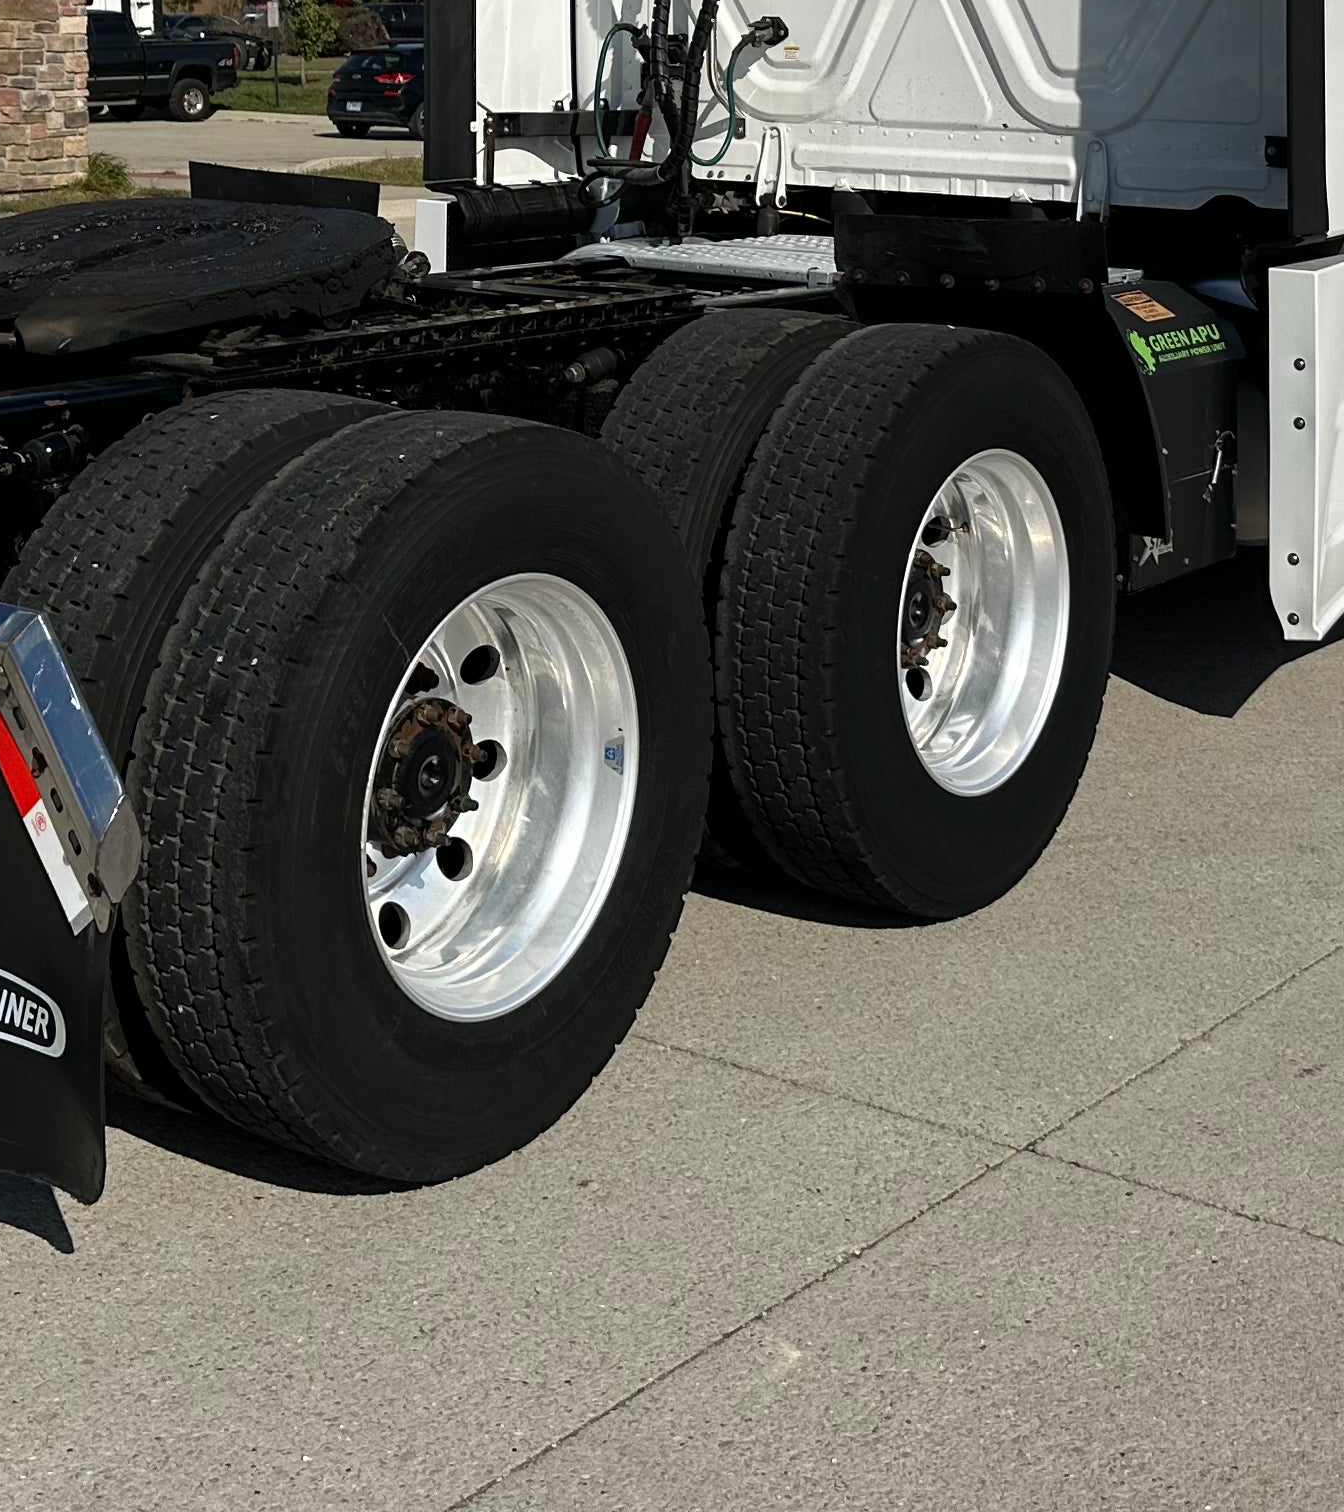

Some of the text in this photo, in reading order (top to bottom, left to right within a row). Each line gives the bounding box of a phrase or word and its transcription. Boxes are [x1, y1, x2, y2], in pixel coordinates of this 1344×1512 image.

[1148, 324, 1220, 352] GREEN APU
[1158, 341, 1227, 363] AUXILIARY POWER UNIT
